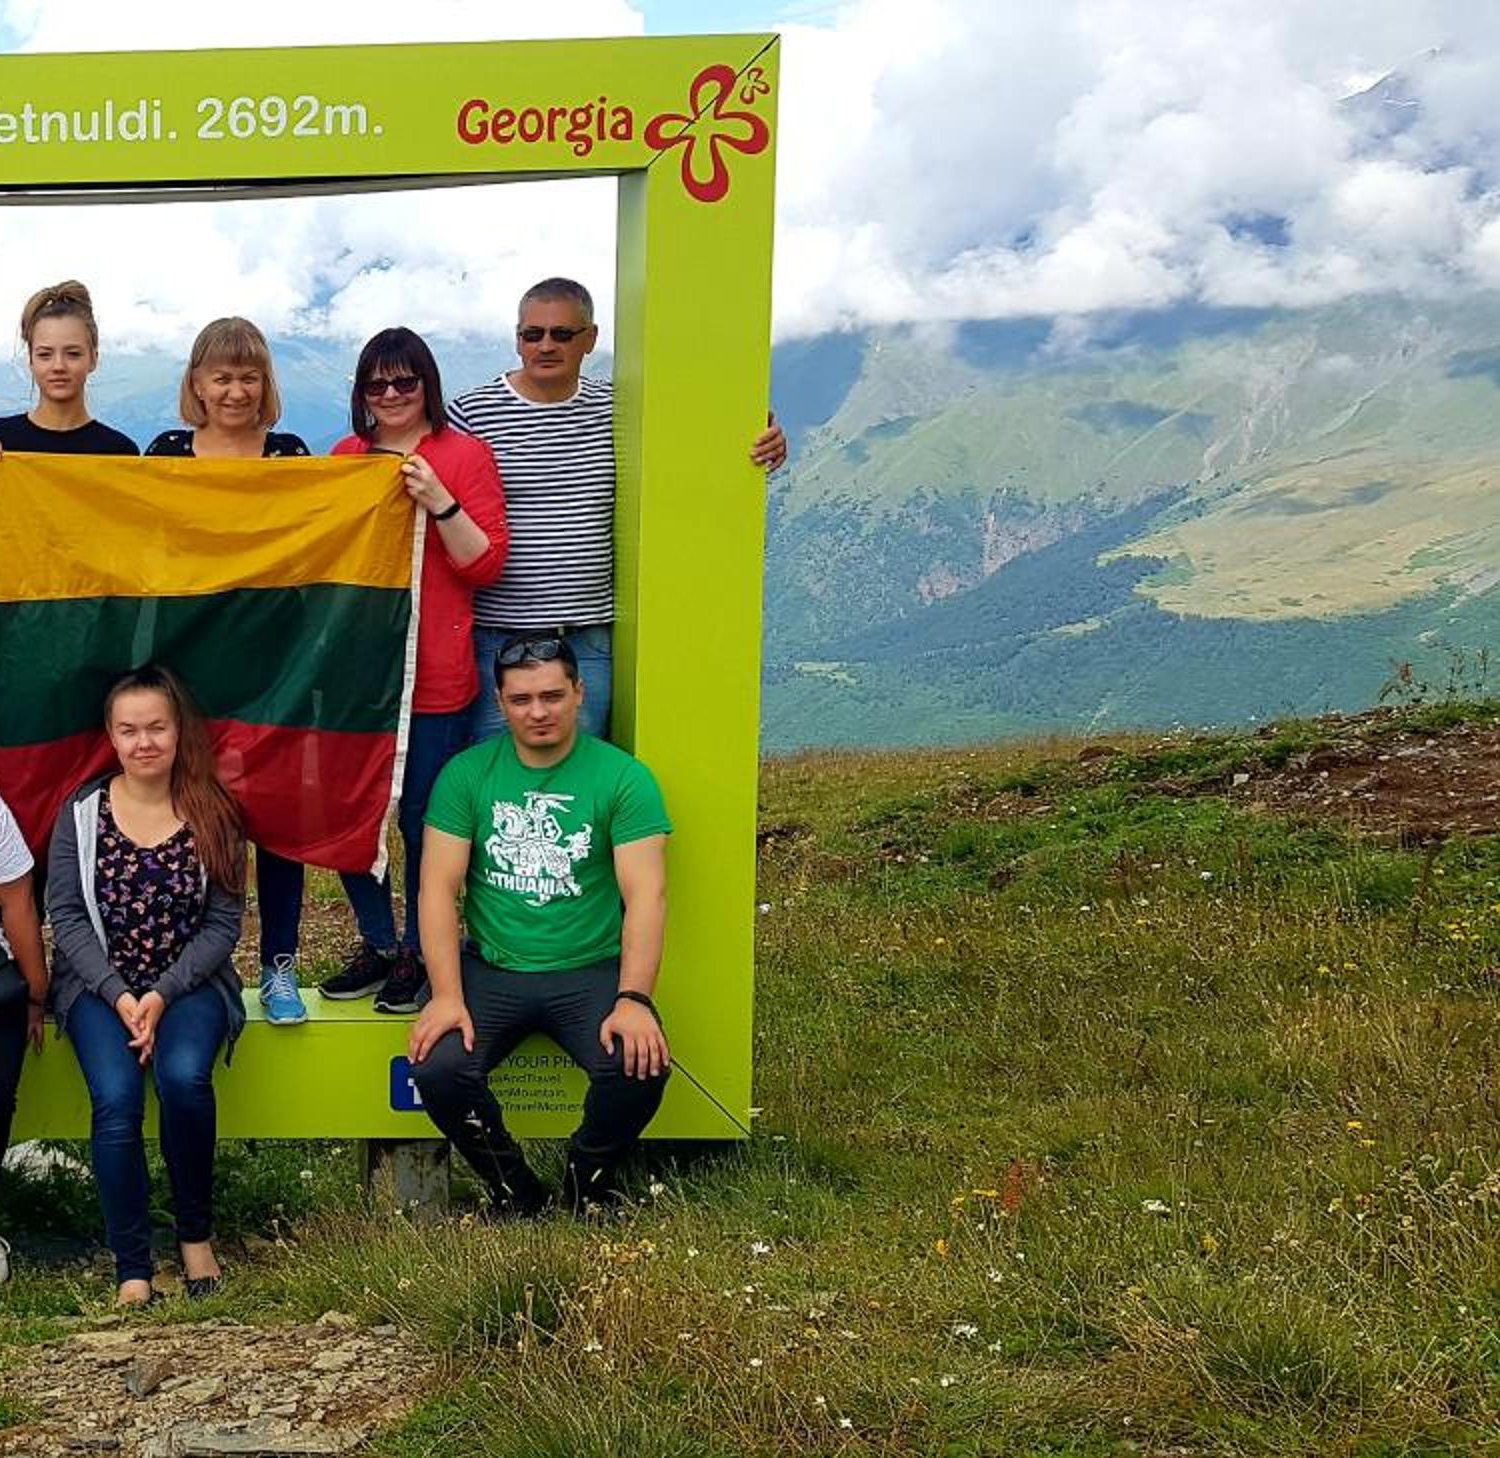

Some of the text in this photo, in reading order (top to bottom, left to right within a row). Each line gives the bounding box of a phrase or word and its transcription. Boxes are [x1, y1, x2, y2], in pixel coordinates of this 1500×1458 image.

[195, 95, 385, 139] 2692m.
[457, 96, 633, 157] Georgia
[485, 868, 567, 895] LITHUANIA
[507, 1055, 548, 1068] YOUR
